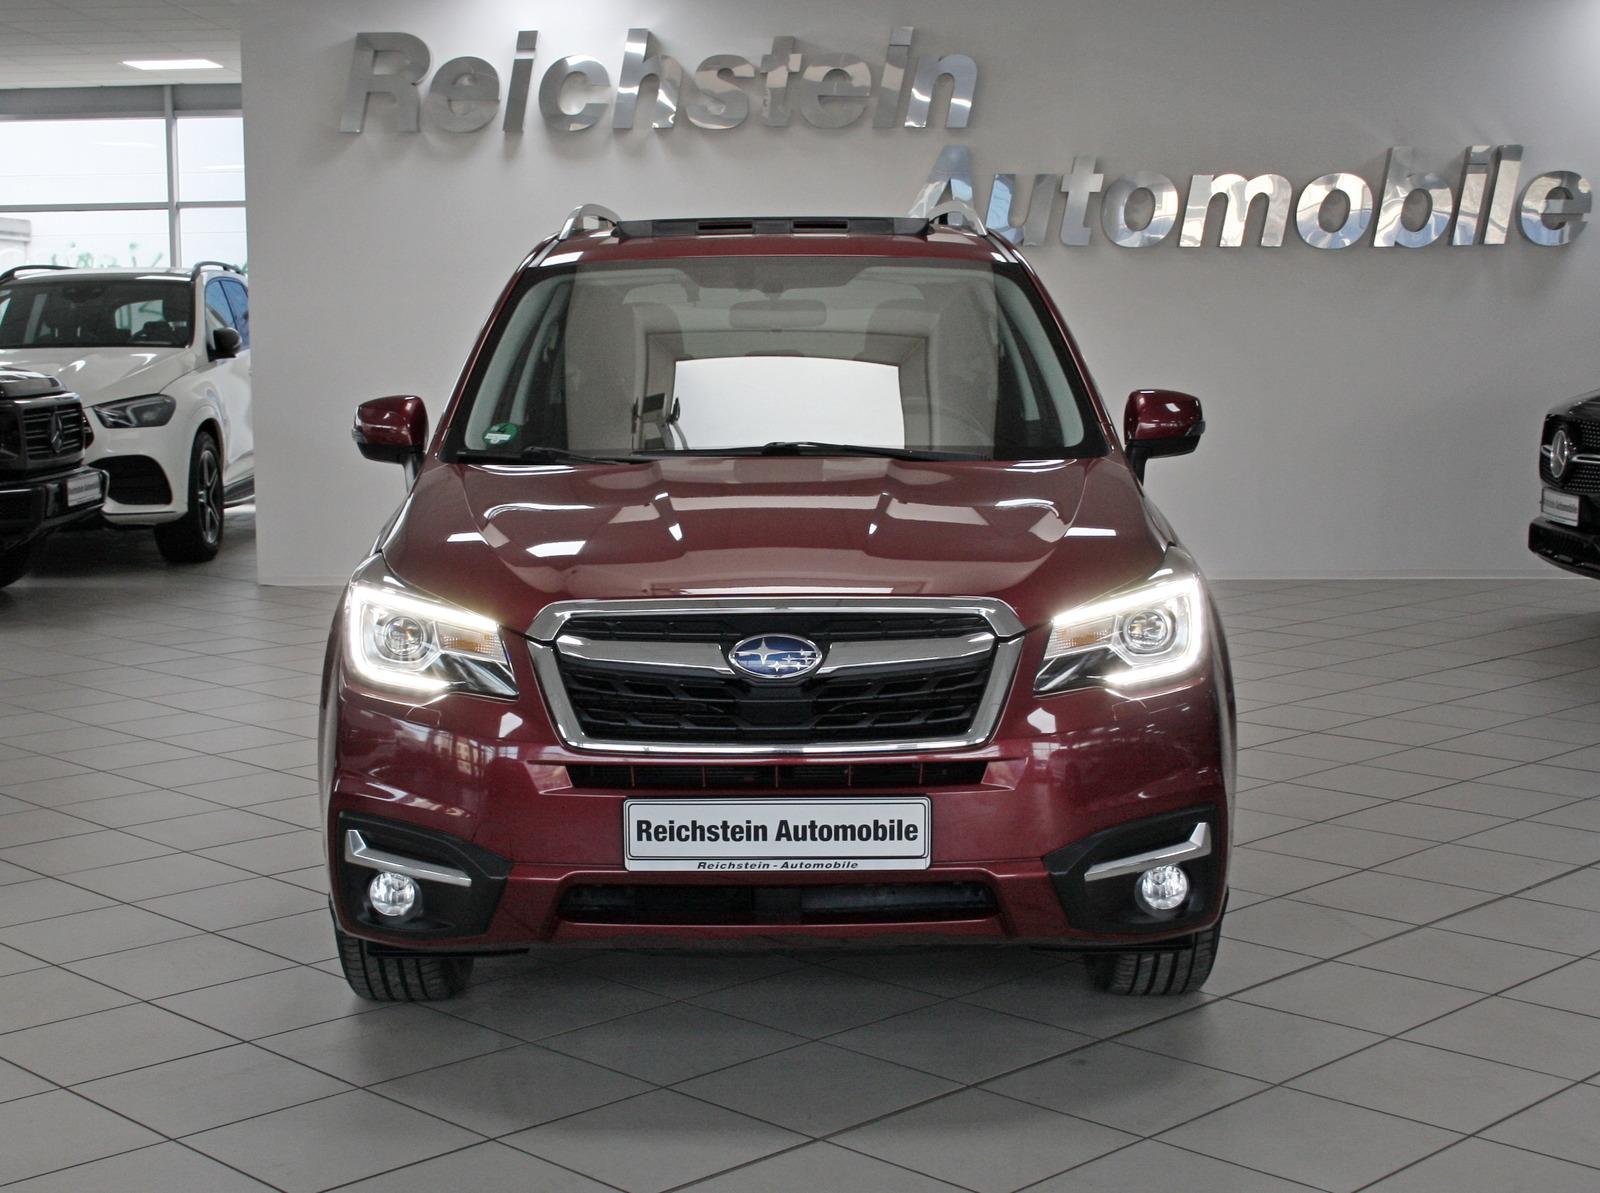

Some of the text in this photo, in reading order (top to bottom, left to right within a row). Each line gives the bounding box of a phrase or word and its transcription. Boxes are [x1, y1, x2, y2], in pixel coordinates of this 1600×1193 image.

[340, 28, 979, 133] Reichstein
[910, 145, 1592, 249] Automobile
[636, 819, 918, 842] Reichstein Automobile
[697, 861, 770, 869] Reichstein
[780, 861, 858, 869] Automobile
